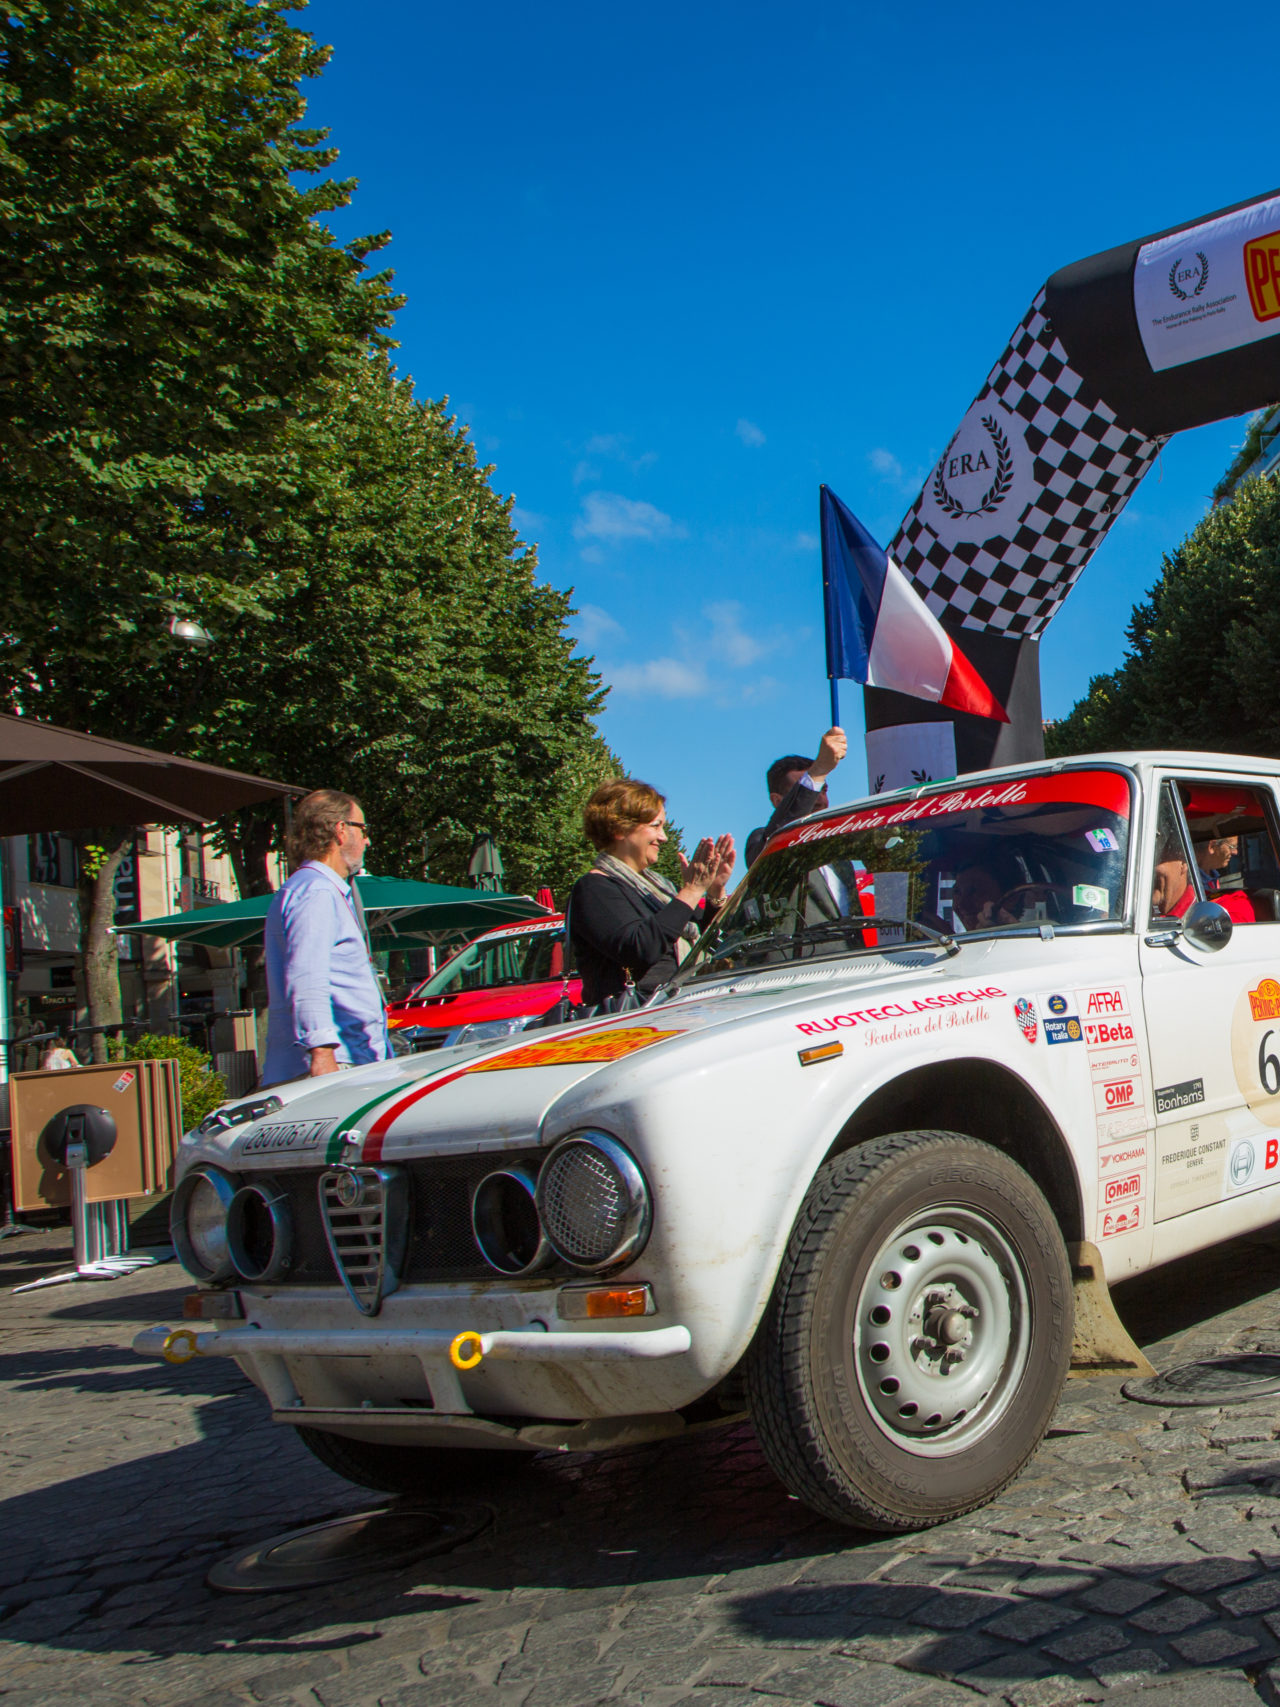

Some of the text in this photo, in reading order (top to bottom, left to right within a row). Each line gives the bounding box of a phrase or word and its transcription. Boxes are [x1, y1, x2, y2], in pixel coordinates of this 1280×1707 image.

[1178, 267, 1200, 283] ERA
[1162, 310, 1192, 323] Endurance
[1192, 303, 1205, 313] Rally
[1206, 294, 1237, 310] Association
[948, 449, 992, 480] ERA
[788, 782, 1028, 848] Scuderia del Portello
[1087, 991, 1123, 1014] AFRA
[864, 1006, 990, 1047] Scuderia del Portello
[1045, 1021, 1066, 1035] Rotary
[1052, 1031, 1069, 1041] Italia
[1098, 1022, 1134, 1043] Beta
[1105, 1084, 1134, 1105] OMP
[1157, 1090, 1204, 1112] Bonhams
[1112, 1147, 1145, 1164] YOKOHAMA
[1162, 1139, 1226, 1165] FREDERIQUE CONSTANT
[1186, 1158, 1204, 1168] GENEVE
[1108, 1179, 1138, 1199] ORAM
